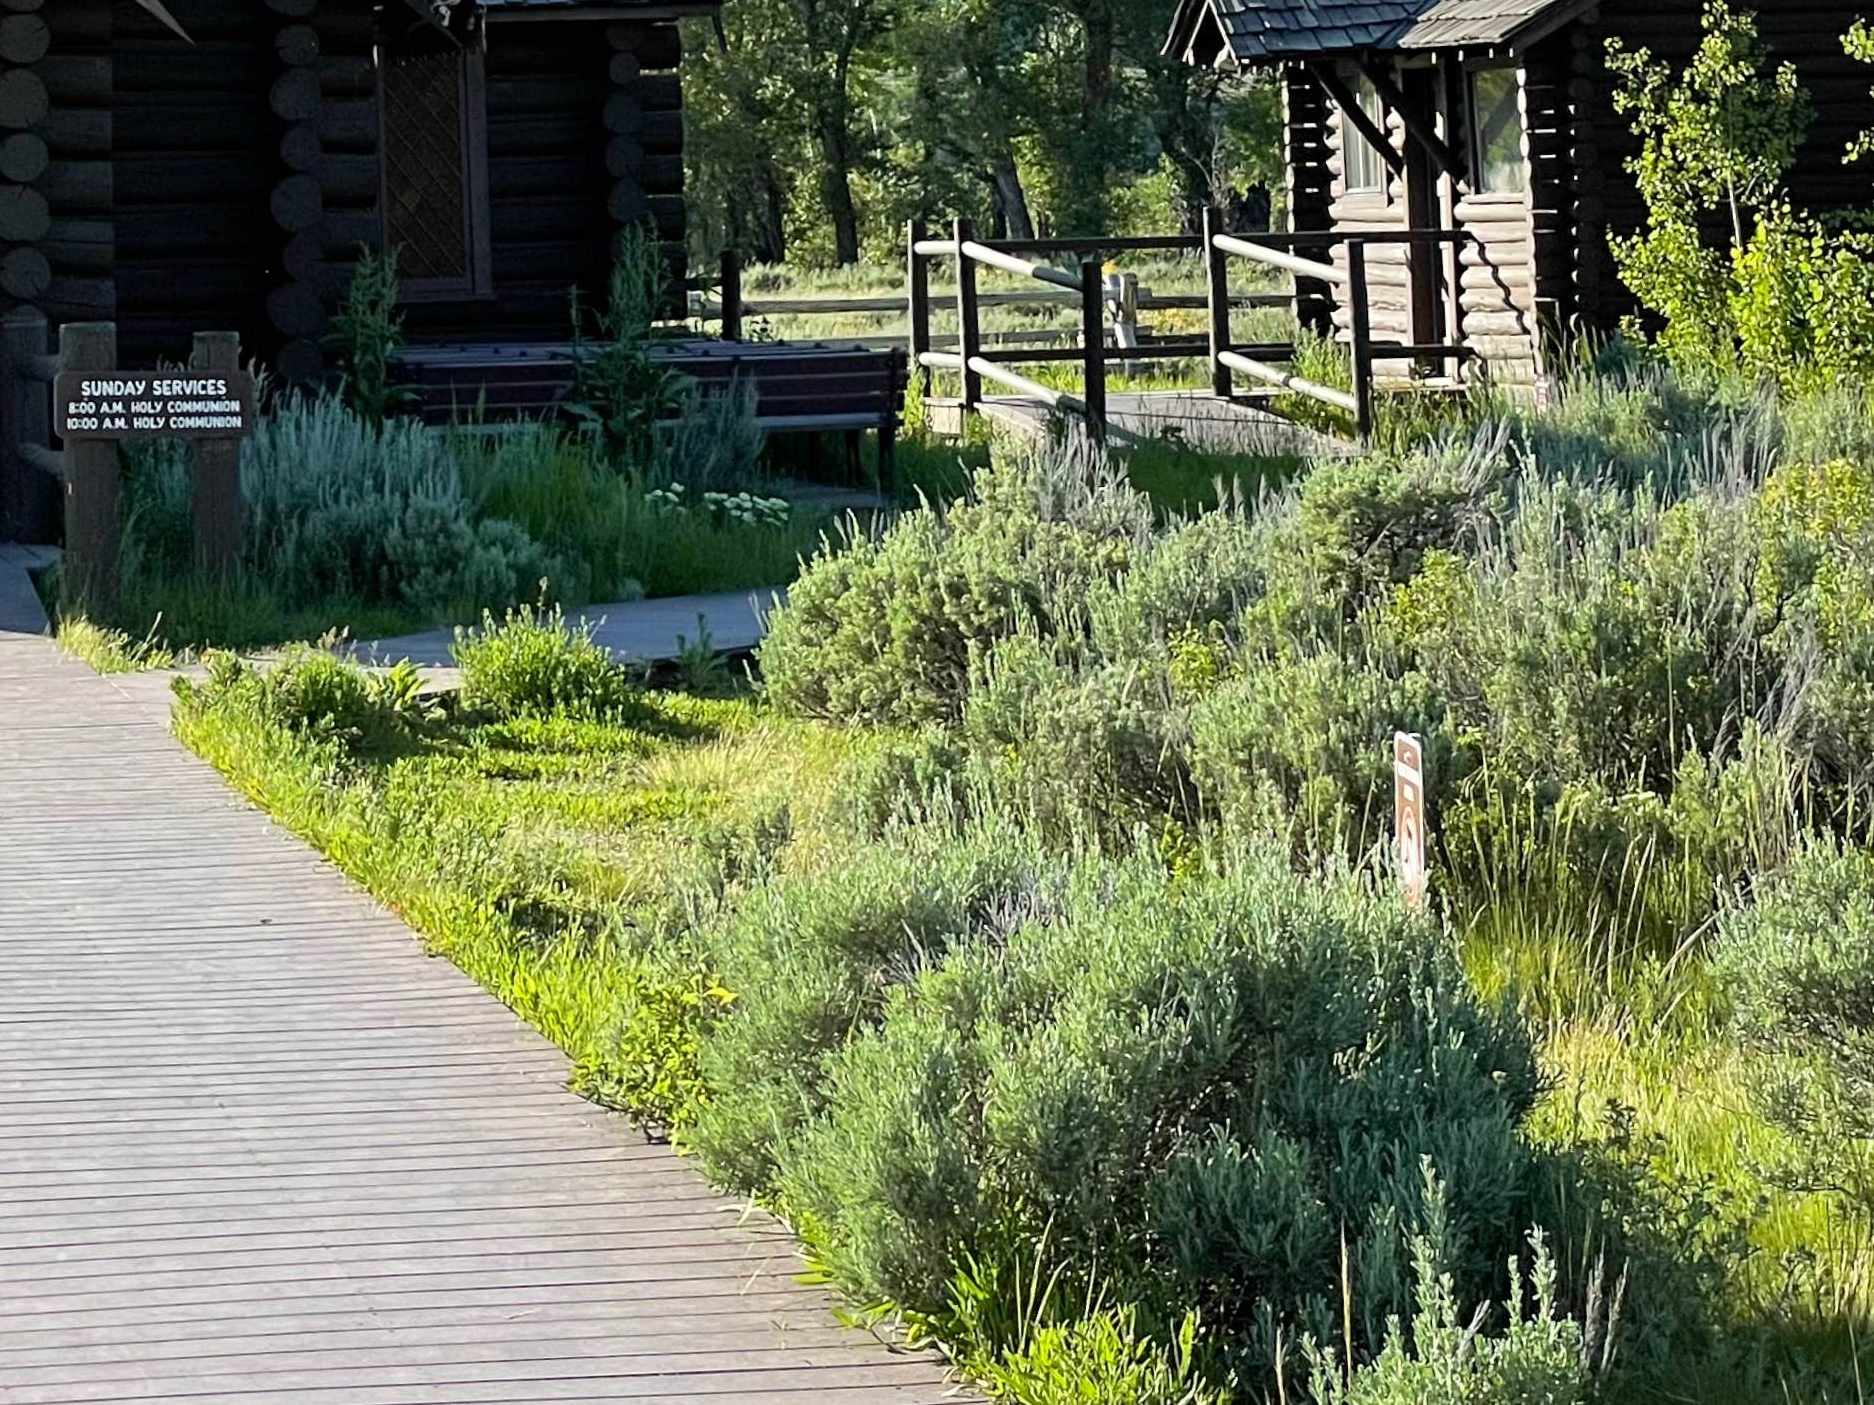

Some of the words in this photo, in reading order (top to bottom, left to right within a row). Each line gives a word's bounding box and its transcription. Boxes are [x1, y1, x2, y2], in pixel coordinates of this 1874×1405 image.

[81, 380, 146, 396] SUNDAY
[152, 379, 227, 395] SERVICES
[68, 402, 96, 414] 8:00
[100, 401, 126, 414] A.M.
[131, 401, 163, 414] HOLY
[167, 400, 241, 413] COMMUNION
[67, 417, 98, 430] 10:00
[102, 417, 128, 429] A.M.
[133, 416, 165, 429] HOLY
[169, 416, 242, 429] COMMUNION
